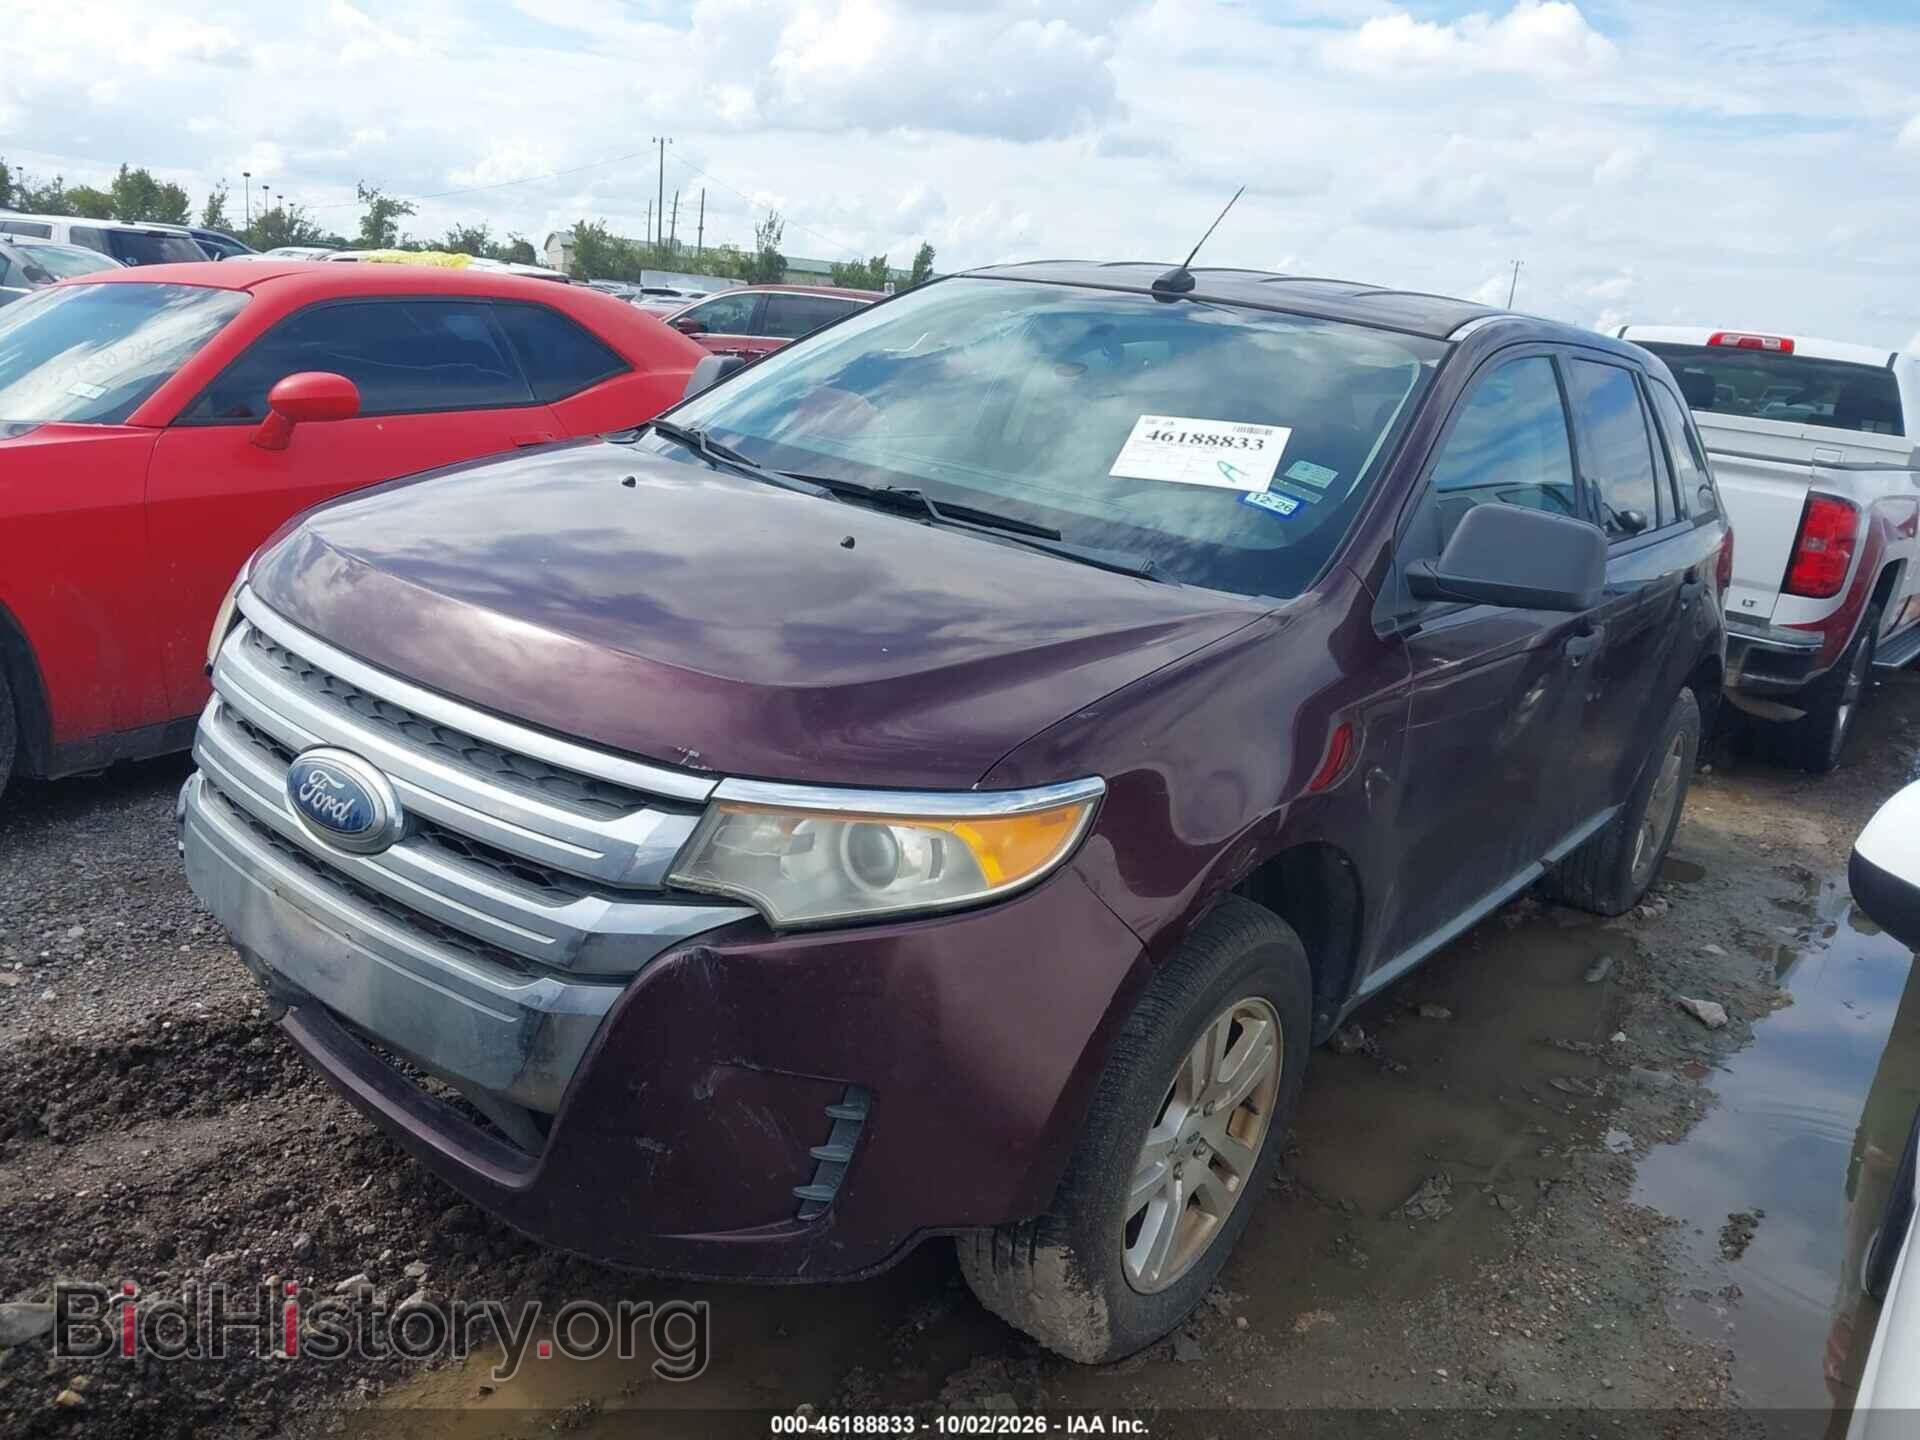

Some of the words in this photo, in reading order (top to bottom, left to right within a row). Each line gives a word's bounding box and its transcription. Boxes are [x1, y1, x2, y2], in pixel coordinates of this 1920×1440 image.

[1146, 430, 1264, 451] 46188833
[1742, 599, 1757, 608] LT
[299, 770, 355, 822] Ford
